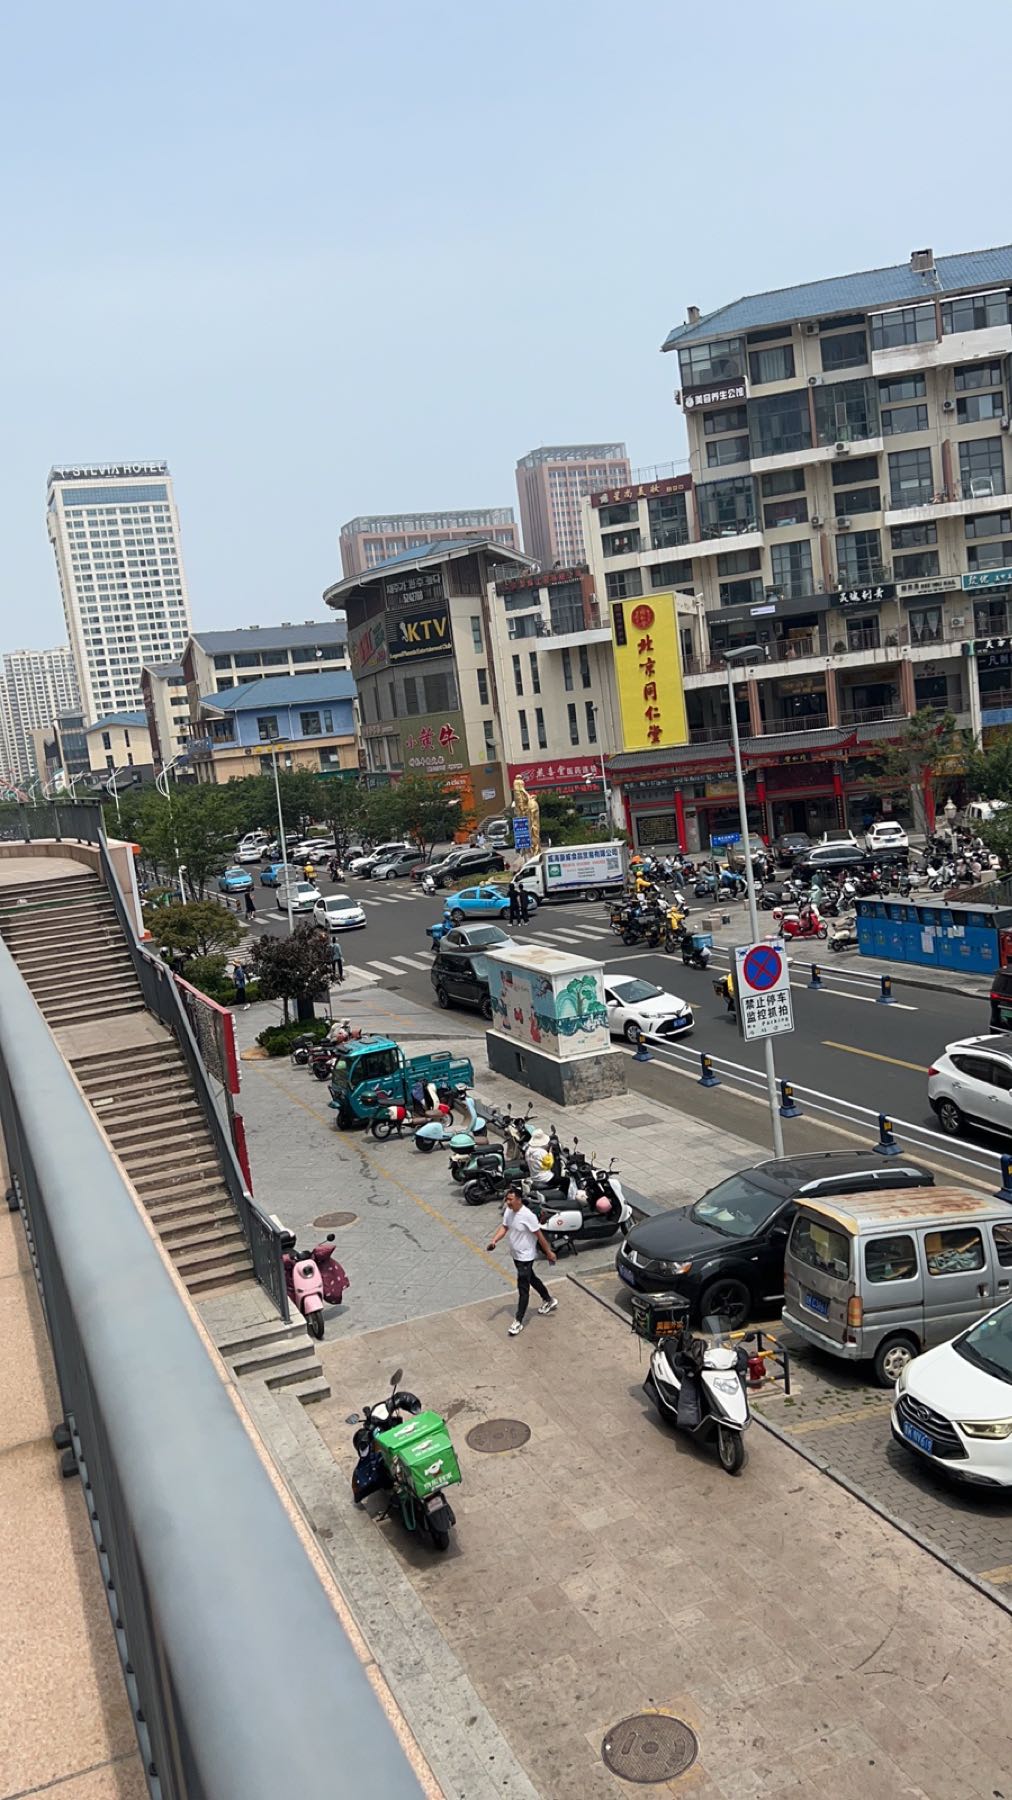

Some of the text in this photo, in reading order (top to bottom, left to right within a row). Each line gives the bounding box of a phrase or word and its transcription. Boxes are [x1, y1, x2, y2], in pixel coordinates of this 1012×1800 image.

[72, 461, 166, 477] SYLVIA HOTEL
[405, 615, 447, 642] KTV
[637, 634, 663, 744] 北京同仁堂
[746, 992, 787, 1009] 禁止停车
[747, 1005, 788, 1023] 监控抓拍
